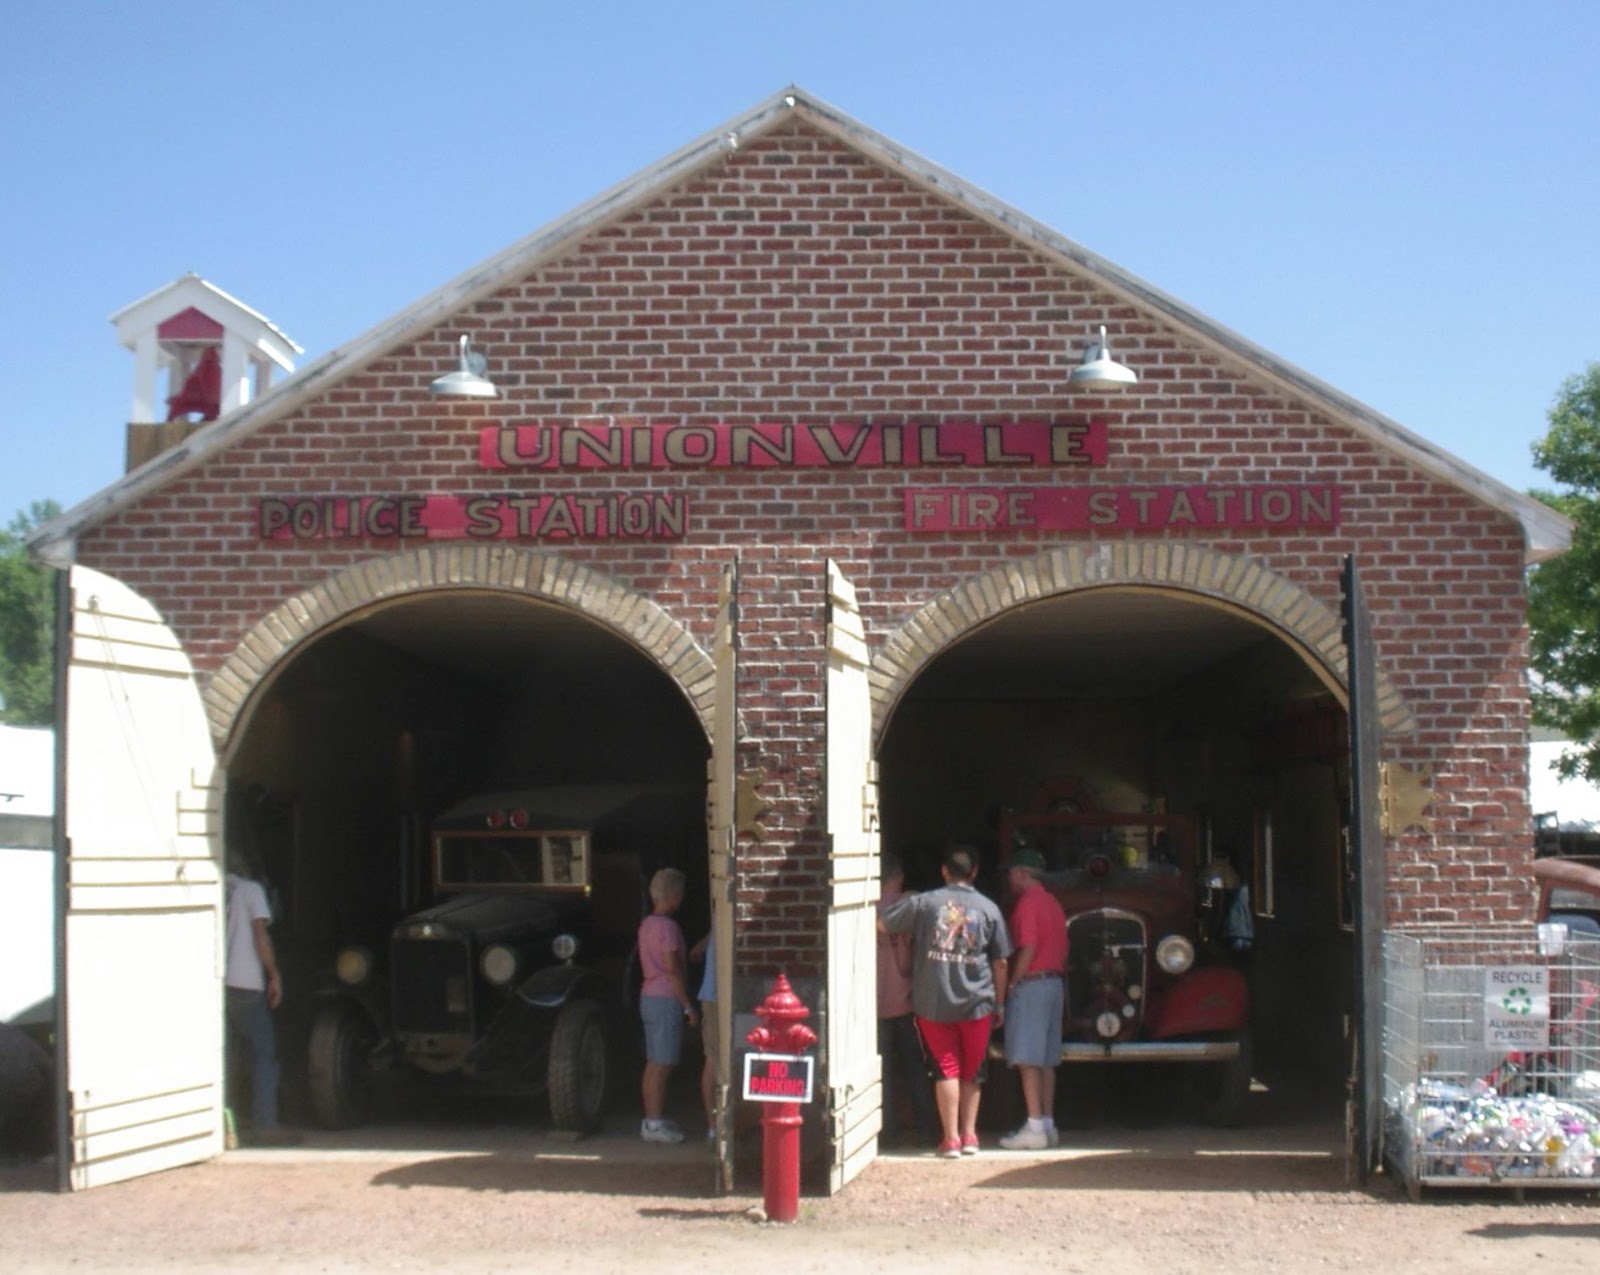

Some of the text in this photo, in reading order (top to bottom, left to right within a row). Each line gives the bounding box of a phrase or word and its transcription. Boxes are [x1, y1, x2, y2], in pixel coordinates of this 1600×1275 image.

[500, 424, 1093, 466] UNIONVILLE
[260, 494, 686, 538] POLICE STATION
[912, 489, 1333, 528] FIRE STATION
[1492, 971, 1543, 984] RECYCLE
[1488, 1019, 1545, 1029] ALUMINUM
[1494, 1030, 1538, 1040] PLASTIC
[767, 1061, 789, 1079] NO
[751, 1076, 805, 1097] PARKING
